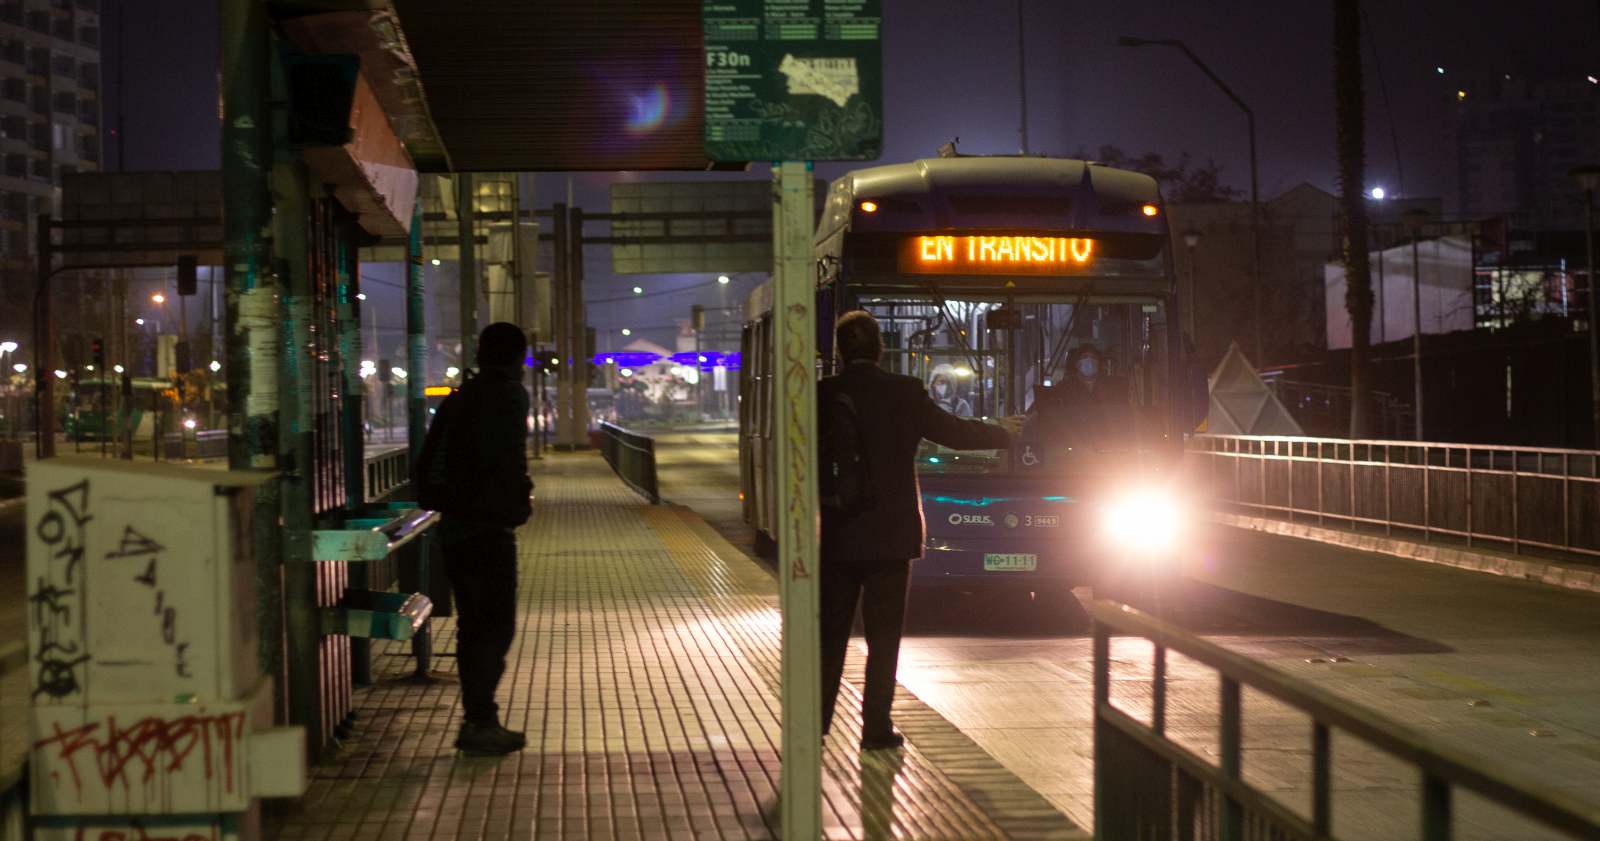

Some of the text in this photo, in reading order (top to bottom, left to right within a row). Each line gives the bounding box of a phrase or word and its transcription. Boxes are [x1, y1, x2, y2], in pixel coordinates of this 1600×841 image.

[707, 52, 751, 67] F30n
[921, 236, 1093, 262] EN TRANSITO
